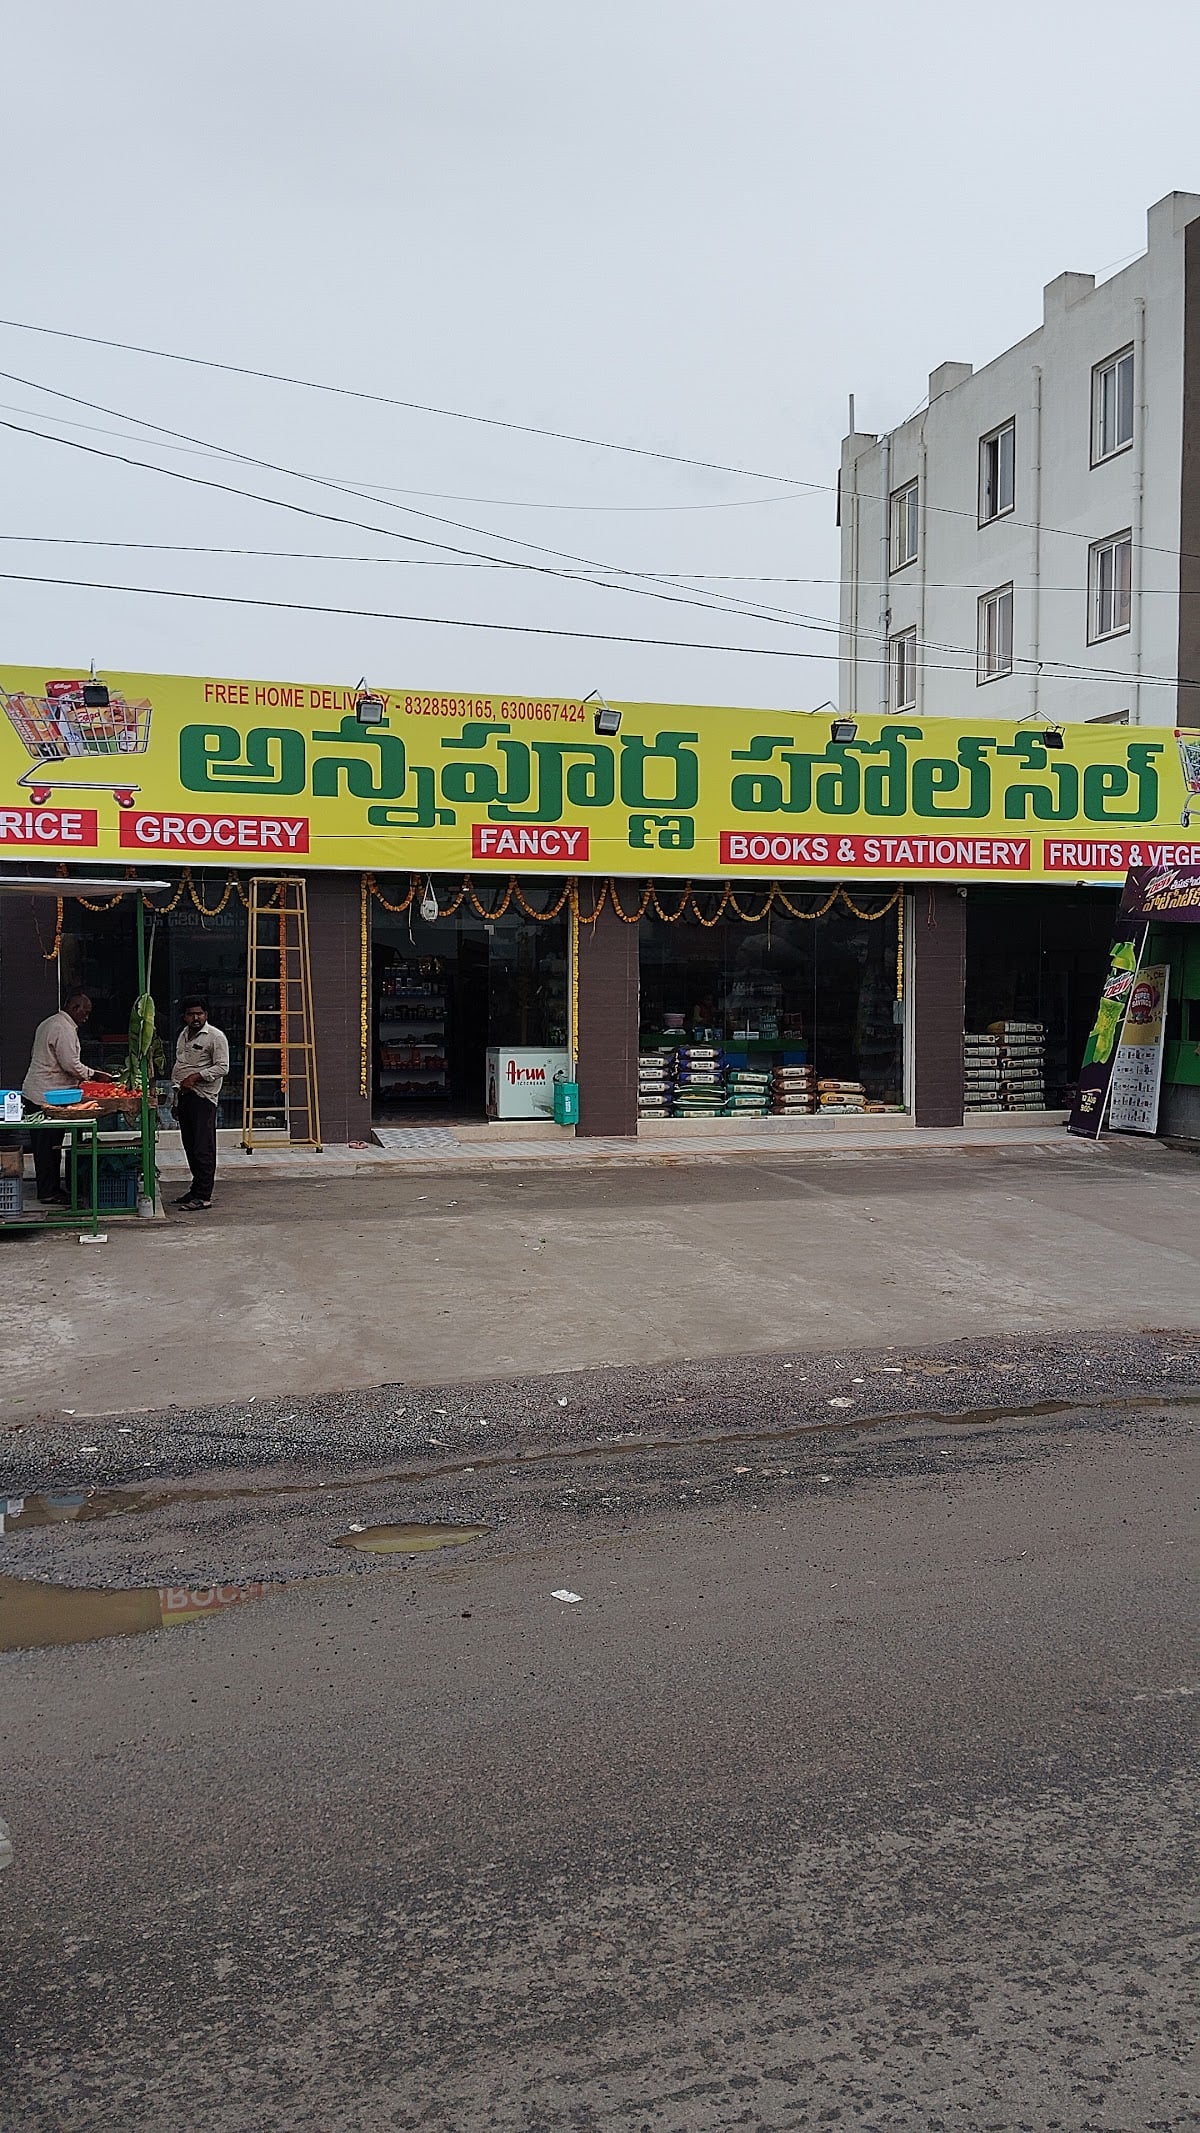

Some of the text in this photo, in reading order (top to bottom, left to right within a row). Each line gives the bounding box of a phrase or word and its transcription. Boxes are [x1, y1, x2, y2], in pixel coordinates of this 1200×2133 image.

[204, 683, 249, 704] FREE
[255, 687, 304, 708] HOME
[310, 690, 391, 713] DELIVY
[405, 696, 496, 721] 8328593165,
[501, 703, 586, 723] 6300667424
[179, 716, 698, 849] అన్నపూర్ణ
[0, 811, 83, 840] RICE
[135, 814, 304, 848] GROCERY
[480, 829, 581, 856] FANCY
[730, 835, 1026, 866] BOOKS & STATIONERY
[1049, 843, 1200, 867] FRUITS & VEGE
[506, 1059, 546, 1086] Arun
